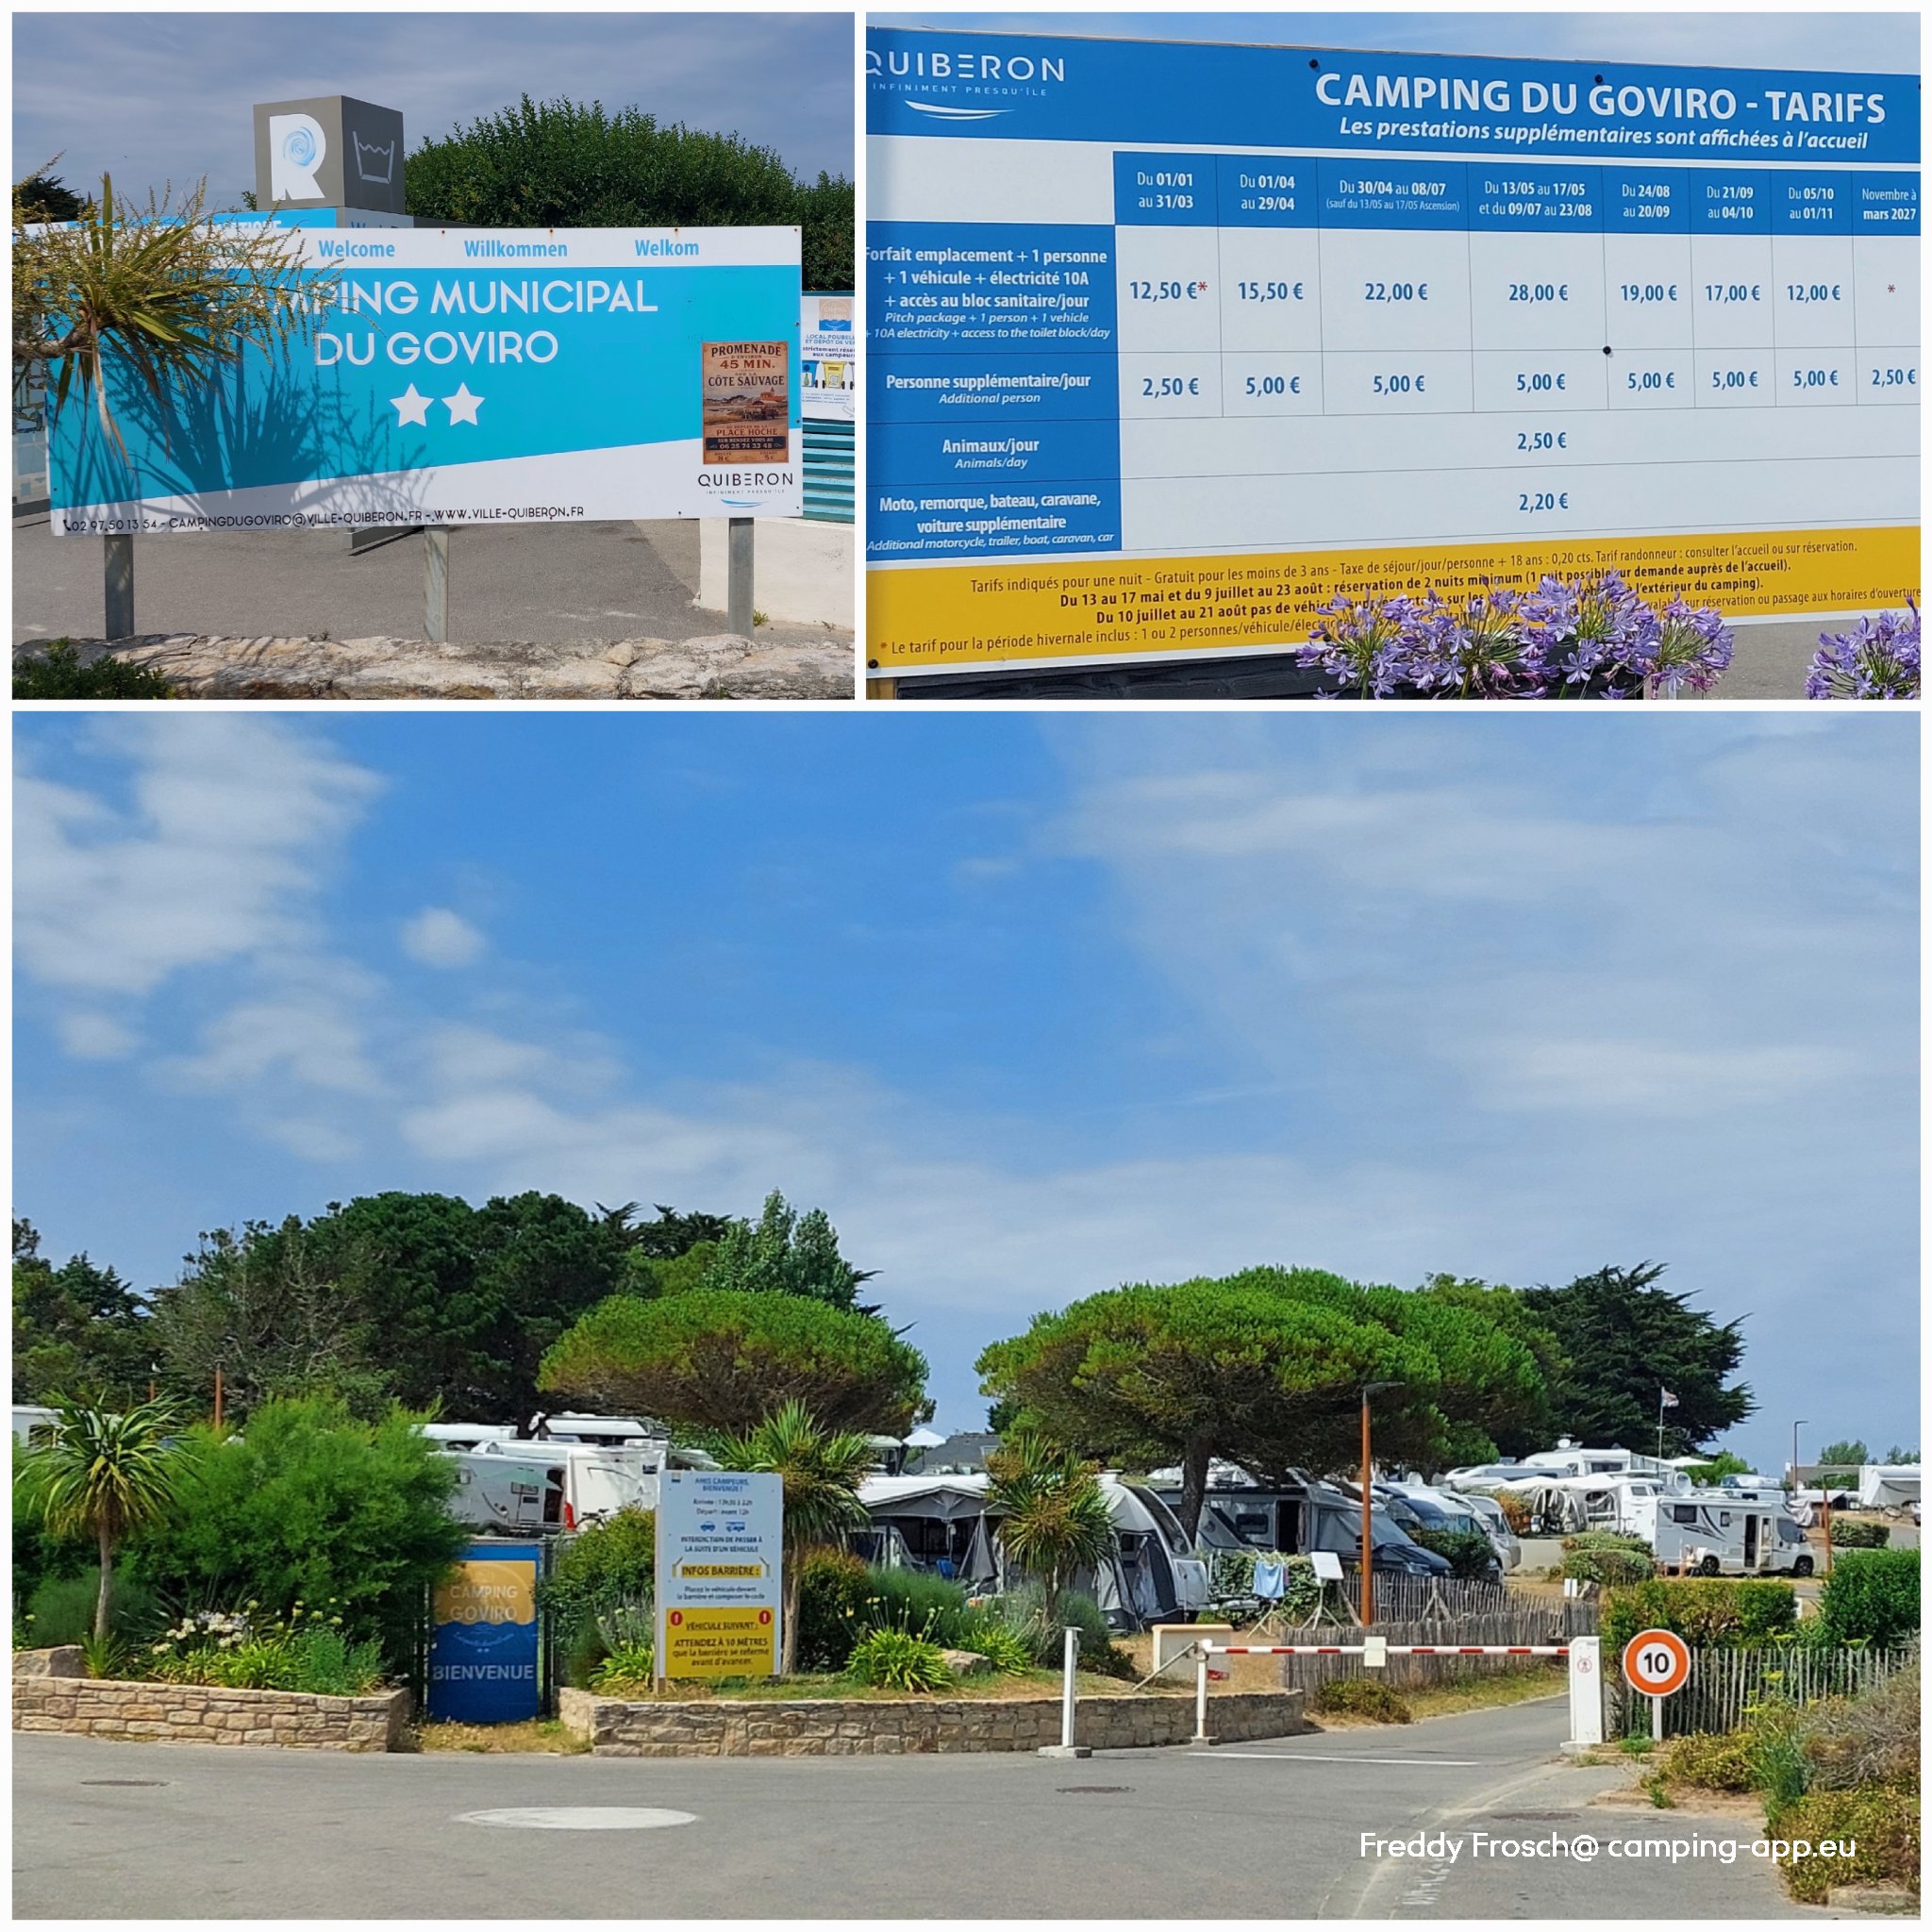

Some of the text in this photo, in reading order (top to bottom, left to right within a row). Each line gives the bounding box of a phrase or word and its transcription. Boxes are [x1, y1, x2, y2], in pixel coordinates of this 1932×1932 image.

[866, 50, 1065, 82] QUIBERON
[873, 83, 1047, 96] INFINIMENT PRESQU'ÎLE
[1316, 73, 1510, 112] CAMPING
[1522, 81, 1576, 114] DU
[1589, 84, 1736, 120] GOVIRO
[1765, 91, 1886, 124] TARIFS
[1340, 117, 1868, 150] Les prestations supplémentaires sont affichées à l'accueil
[270, 113, 325, 200] R
[1137, 172, 1193, 187] Du 01/01
[1240, 174, 1295, 189] Du 01/04
[1340, 179, 1446, 195] Du 30/04 au 08/07
[1485, 181, 1585, 197] Du 13/05 au 17/05
[1622, 184, 1670, 198] Du 24/08
[1707, 186, 1754, 199] Du 21/09
[1789, 188, 1834, 200] Du 05/10
[1862, 188, 1917, 201] Novembre à
[1139, 194, 1193, 209] au 31/03
[1241, 196, 1295, 210] au 29/04
[1478, 202, 1592, 218] et du 09/07 au 23/08
[1623, 205, 1670, 218] au 20/09
[1707, 206, 1754, 220] au 04/10
[1790, 207, 1833, 220] au 01/11
[1863, 208, 1917, 221] mars 2027
[319, 240, 395, 258] Welcome
[464, 240, 567, 258] Willkommen
[635, 239, 699, 256] Welkom
[915, 248, 1014, 265] emplacement
[1032, 249, 1039, 261] 1
[1043, 251, 1108, 266] personne
[900, 272, 907, 283] 1
[911, 271, 972, 284] véhicule
[990, 271, 1060, 285] électricité
[1063, 273, 1090, 286] 10A
[430, 280, 658, 315] MUNICIPAL
[1129, 281, 1180, 302] 12,50
[1238, 282, 1304, 302] 15,50 €
[1365, 283, 1428, 303] 22,00 €
[1508, 284, 1569, 304] 28,00 €
[1620, 285, 1677, 304] 19,00 €
[1705, 285, 1760, 304] 17,00 €
[1787, 285, 1840, 303] 12,00 €
[900, 293, 938, 308] accès
[941, 296, 958, 308] au
[962, 293, 991, 308] bloc
[994, 293, 1090, 310] sanitaire/jour
[315, 330, 558, 365] DU GOVIRO
[711, 344, 781, 358] PROMENADE
[720, 359, 775, 369] 45 MIN.
[708, 375, 785, 387] CÔTE SAUVAGE
[886, 373, 1091, 391] Personne supplémentaire/jour
[939, 393, 1041, 406] Additional person
[942, 438, 1040, 455] Animaux/jour
[1517, 432, 1567, 453] 2,50 €
[955, 458, 1028, 470] Animals/day
[698, 473, 793, 488] QUIBERON
[879, 492, 1101, 513] Moto, remorque, bateau, caravane,
[1519, 492, 1569, 513] 2,20 €
[72, 522, 87, 531] 02
[91, 521, 105, 530] 97
[108, 520, 124, 530] 50
[127, 520, 140, 529] 13
[142, 519, 158, 529] 54
[169, 510, 423, 528] CAMPINGDUGOVIRO@VILLE-QUIBERON.FR
[434, 507, 584, 520] WWW.VILLE-QUIBERON.FR
[917, 515, 1067, 535] voiture supplémentaire
[1732, 541, 1857, 557] l'accueil ou sur réservation.
[1060, 583, 1324, 607] Du 13 au 17 mai et du 9 juillet au 23 août
[682, 1565, 754, 1576] INFOS BARRIÈRE
[450, 1586, 518, 1599] CAMPING
[450, 1606, 517, 1621] GOVIRO
[675, 1638, 716, 1647] ATTENDEZ
[725, 1638, 735, 1646] 10
[737, 1637, 768, 1646] MÈTRES
[1644, 1653, 1670, 1674] 10
[433, 1665, 534, 1680] BIENVENUE
